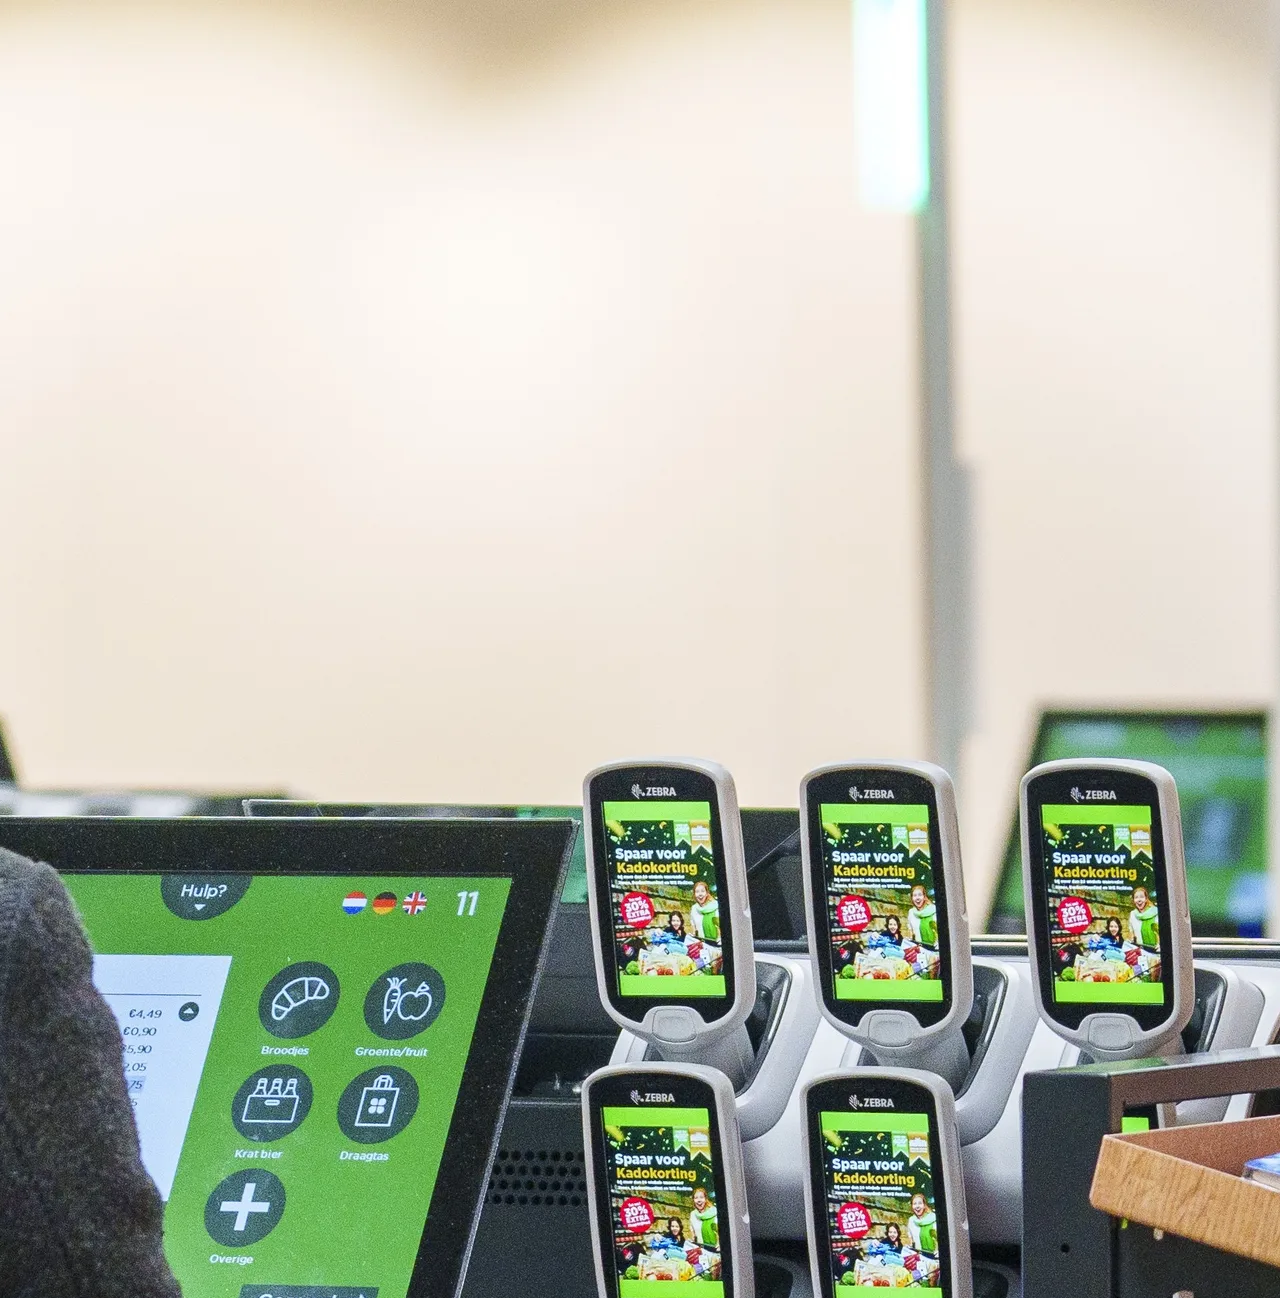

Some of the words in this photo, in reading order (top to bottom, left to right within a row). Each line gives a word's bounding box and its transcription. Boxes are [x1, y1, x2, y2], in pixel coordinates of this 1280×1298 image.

[646, 786, 676, 796] ZEBRA
[864, 789, 894, 799] ZEBRA
[1086, 790, 1116, 800] ZEBRA
[615, 848, 654, 861] Spaar
[656, 850, 686, 860] voor
[832, 850, 871, 864] Spaar
[874, 852, 904, 862] voor
[1052, 852, 1092, 866] Spaar
[1096, 854, 1126, 864] voor
[616, 862, 698, 875] Kadokorting
[834, 864, 914, 879] Kadokorting
[1054, 866, 1137, 880] Kadokorting
[181, 884, 228, 899] Hulp?
[456, 891, 478, 916] 11
[624, 900, 648, 912] 30%
[626, 909, 650, 918] EXTRA
[841, 904, 866, 916] 30%
[1061, 904, 1086, 918] 30%
[842, 912, 867, 922] EXTRA
[1062, 914, 1088, 924] EXTRA
[129, 1009, 162, 1020] €4,49
[123, 1027, 157, 1038] €0,90
[261, 1045, 310, 1057] Broodjes
[355, 1046, 428, 1058] Groente/fruit
[645, 1093, 675, 1102] ZEBRA
[864, 1098, 894, 1108] ZEBRA
[234, 1150, 259, 1159] Krat
[260, 1150, 282, 1160] bier
[339, 1151, 389, 1162] Draagtas
[615, 1153, 652, 1166] Spaar
[656, 1154, 686, 1165] voor
[832, 1158, 871, 1172] Spaar
[874, 1160, 904, 1171] voor
[616, 1167, 697, 1182] Kadokorting
[834, 1172, 915, 1187] Kadokorting
[624, 1206, 648, 1218] 30%
[841, 1210, 866, 1222] 30%
[626, 1214, 650, 1223] EXTRA
[842, 1220, 868, 1228] EXTRA
[209, 1254, 254, 1266] Overige
